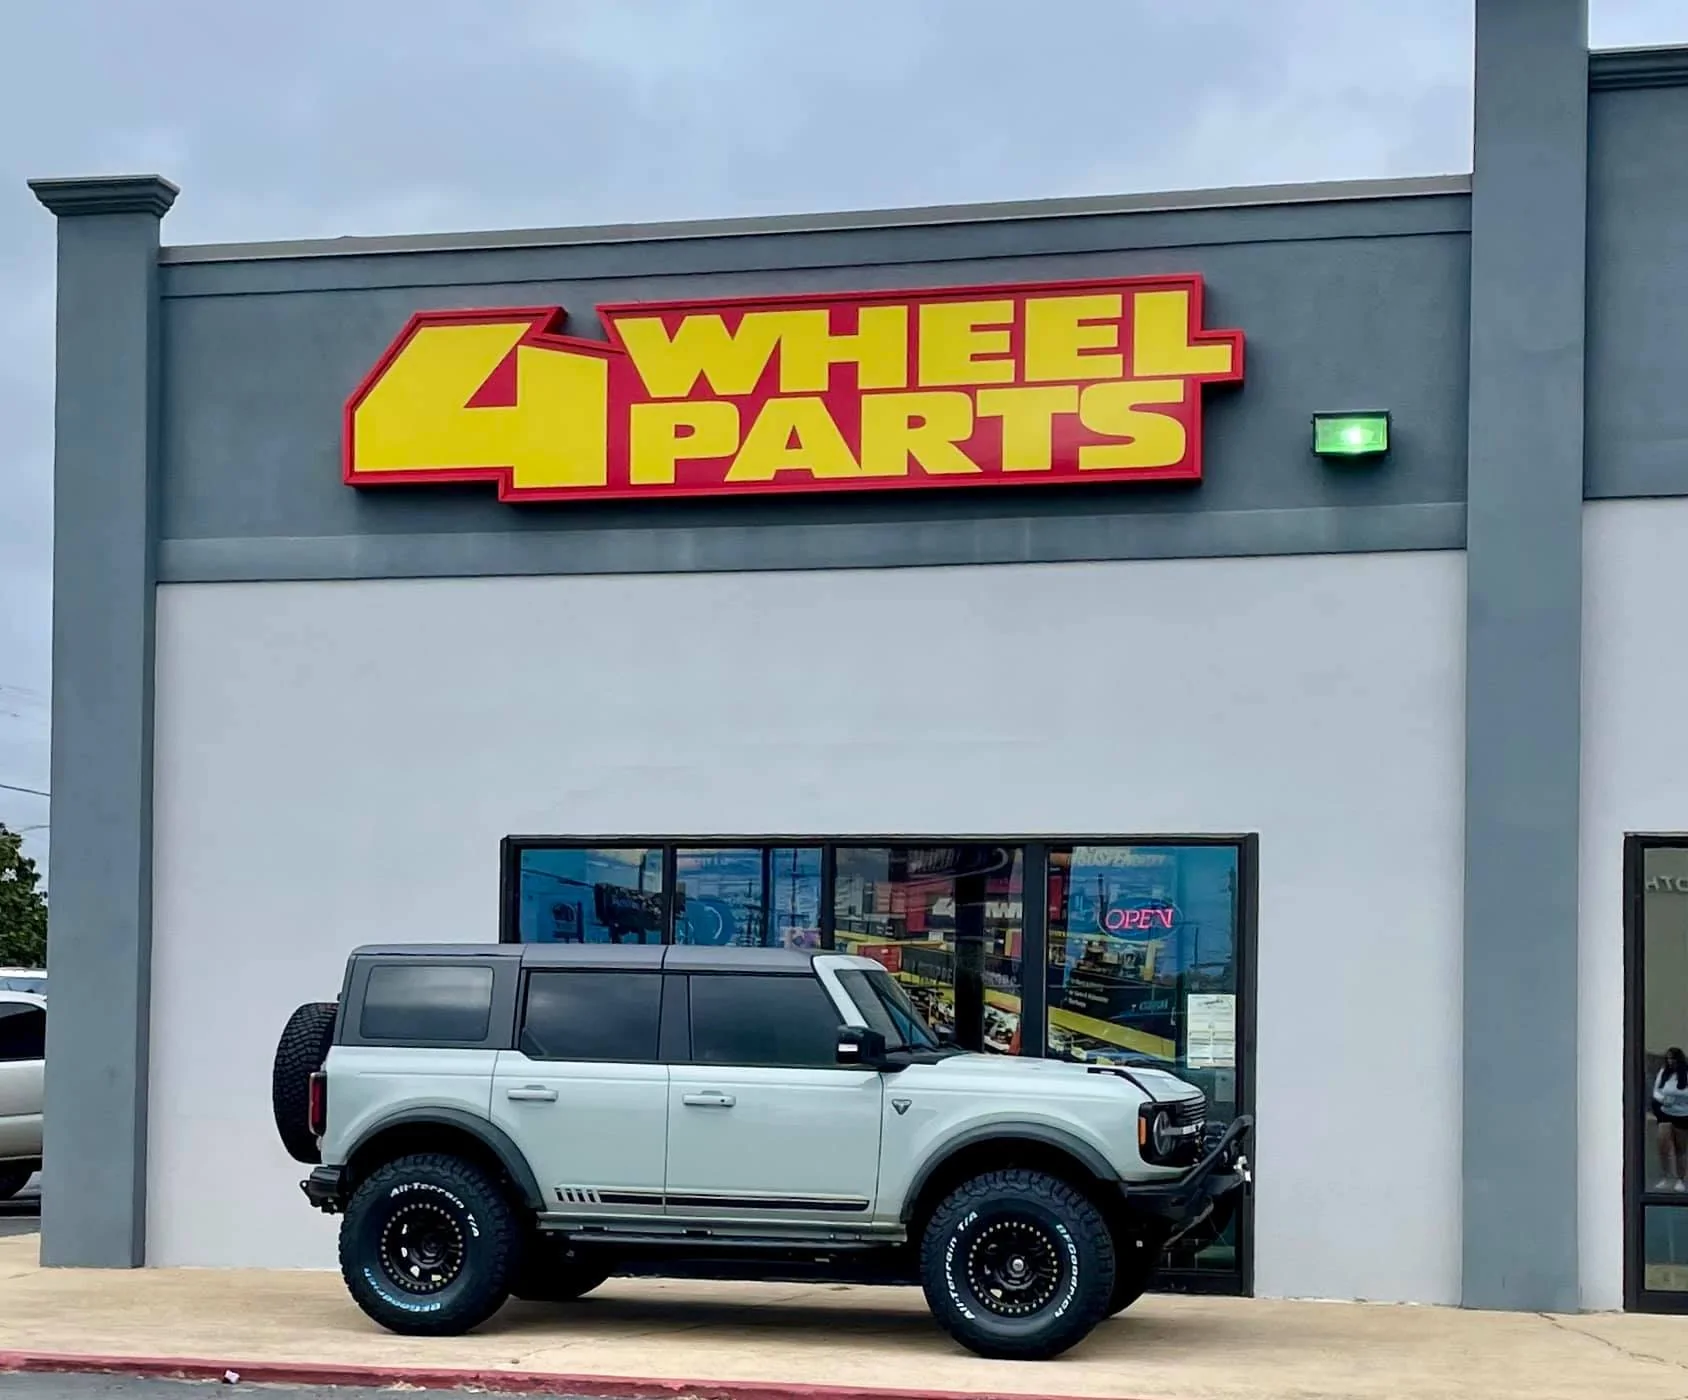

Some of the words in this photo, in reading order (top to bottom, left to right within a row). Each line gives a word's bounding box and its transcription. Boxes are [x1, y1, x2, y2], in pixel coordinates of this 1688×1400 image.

[354, 322, 609, 489] 4
[613, 289, 1233, 398] WHEEL
[629, 379, 1186, 485] PARTS
[1104, 908, 1175, 931] OPEN
[956, 1210, 979, 1232] T/A
